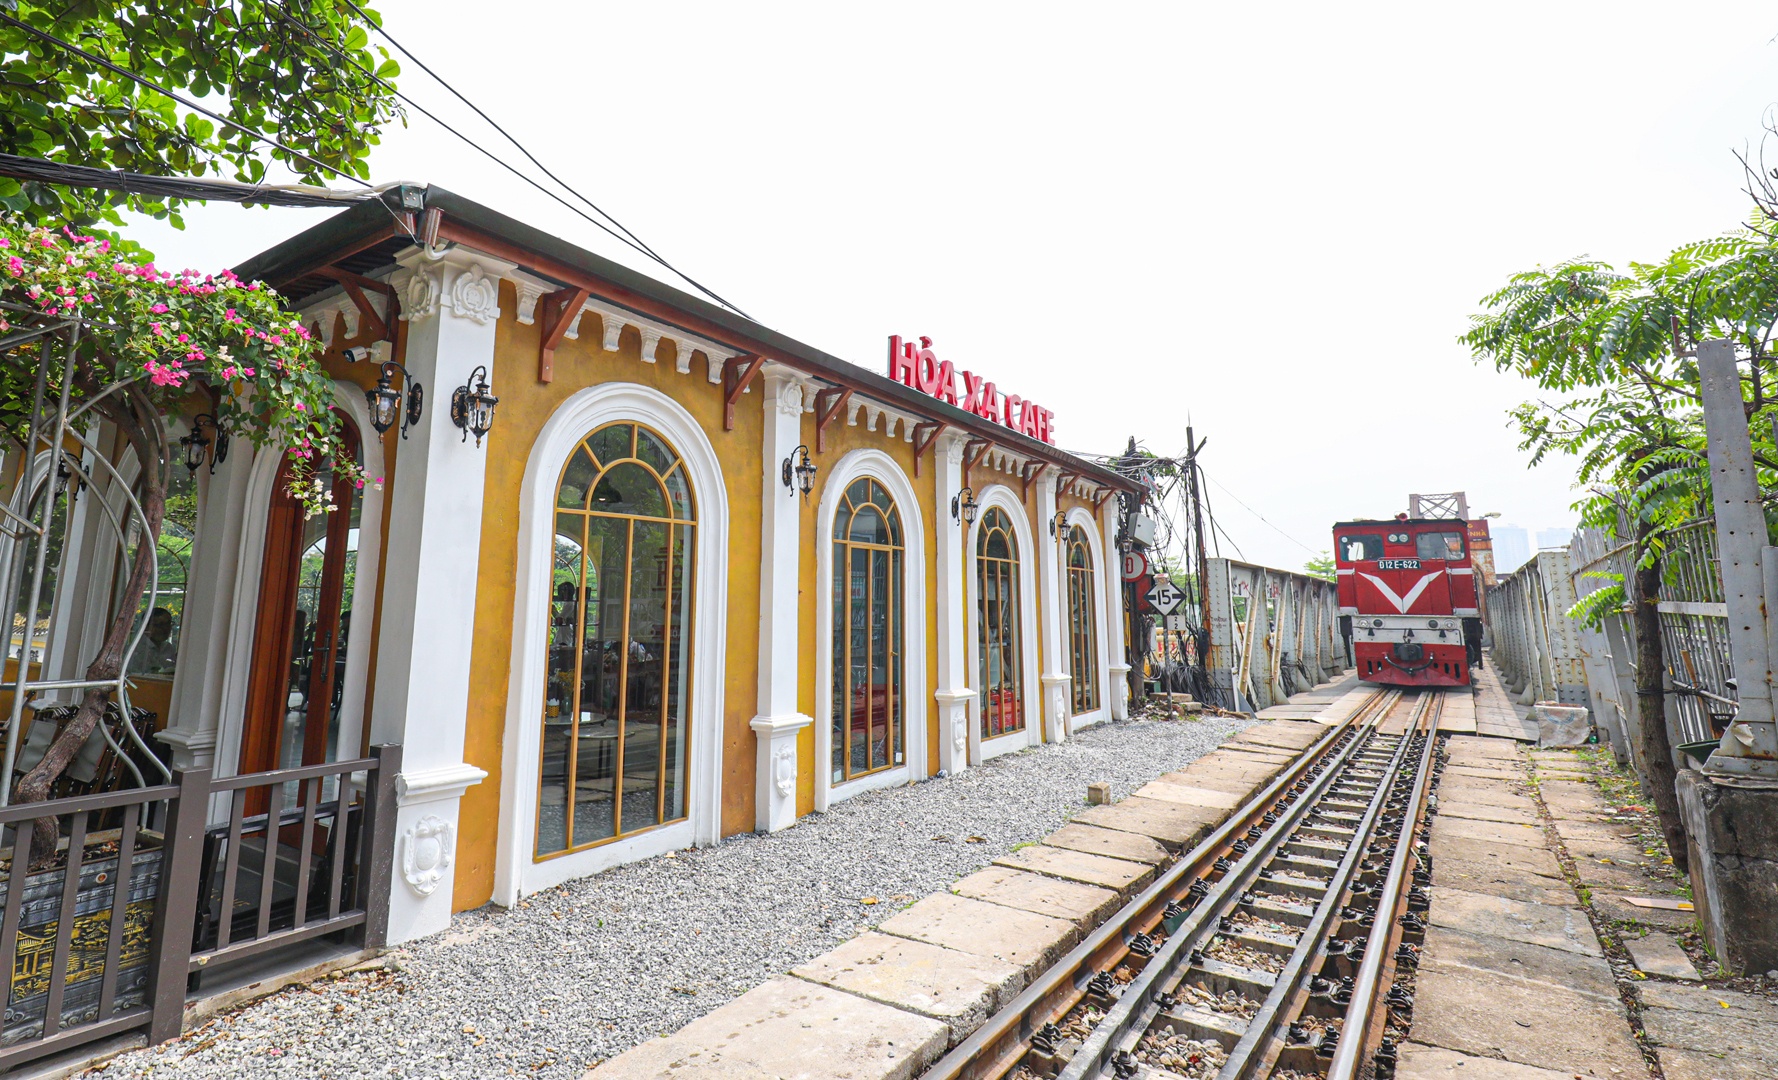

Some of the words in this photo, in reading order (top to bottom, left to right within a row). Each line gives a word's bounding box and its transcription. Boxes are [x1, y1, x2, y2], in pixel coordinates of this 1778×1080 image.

[888, 334, 958, 407] HỎA
[962, 370, 1001, 425] XA
[1004, 393, 1056, 447] CAFE
[1469, 529, 1487, 537] NHÀ
[1157, 589, 1172, 606] 15
